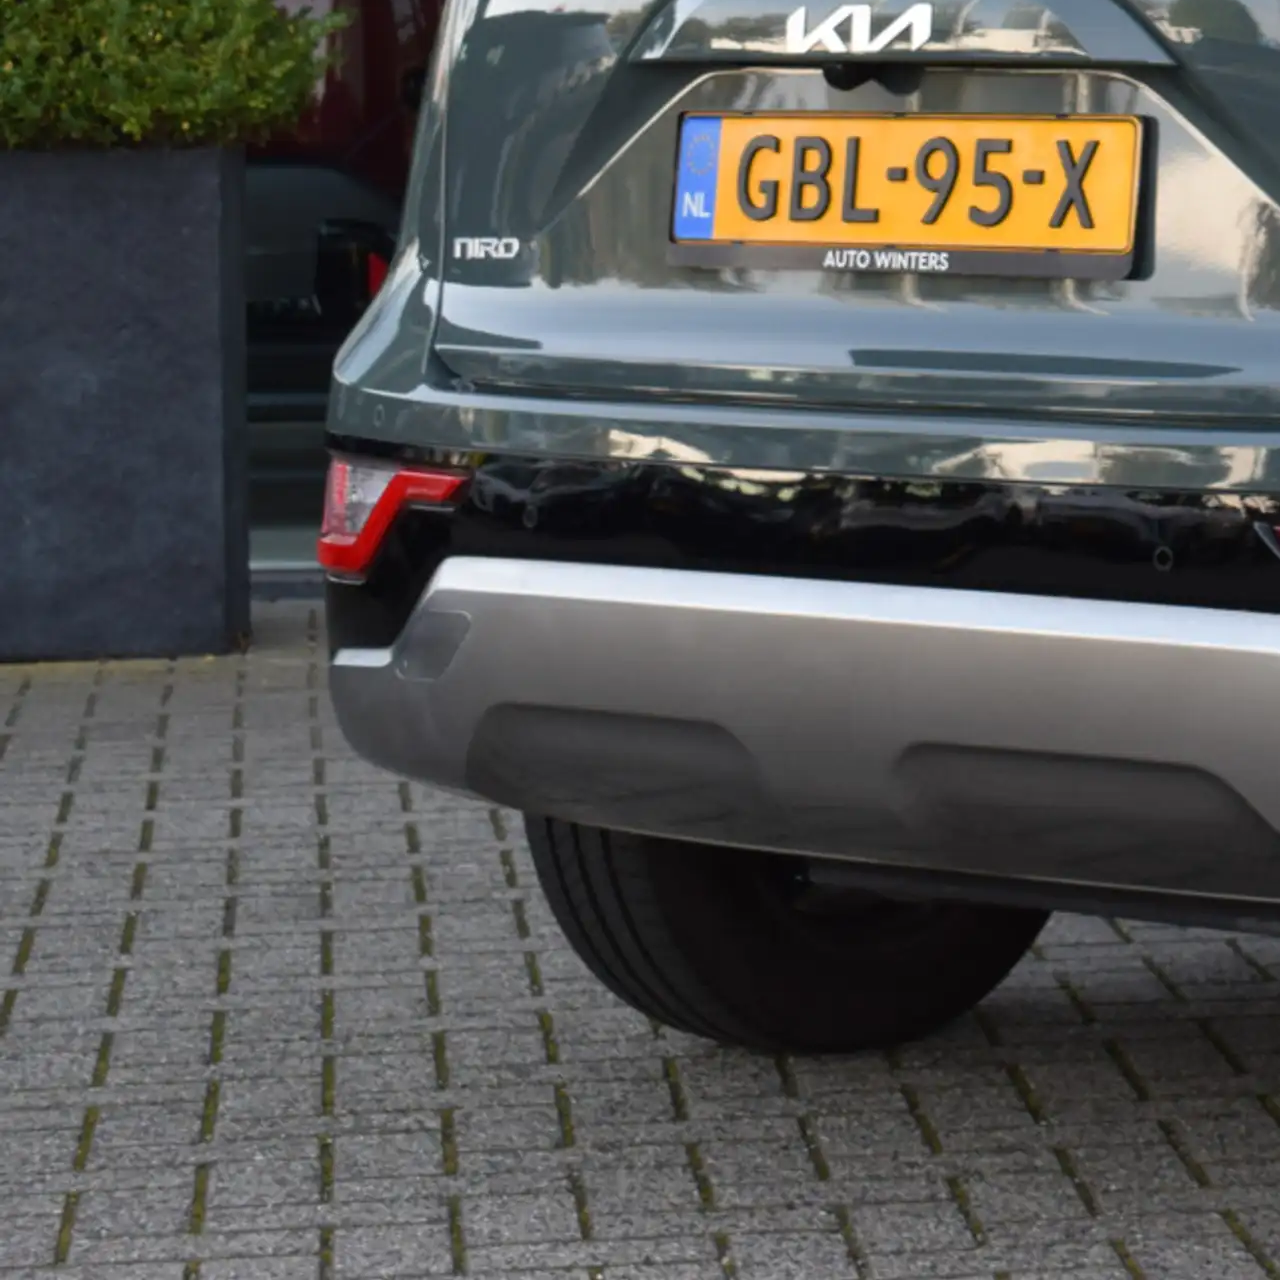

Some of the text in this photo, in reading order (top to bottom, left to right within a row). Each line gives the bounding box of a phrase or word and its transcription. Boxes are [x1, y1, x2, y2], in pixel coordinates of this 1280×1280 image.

[786, 3, 932, 53] KIA
[736, 134, 1101, 230] GBL-95-X
[682, 191, 711, 219] NL
[453, 236, 521, 260] NIRO
[822, 250, 950, 272] AUTO WINTERS
